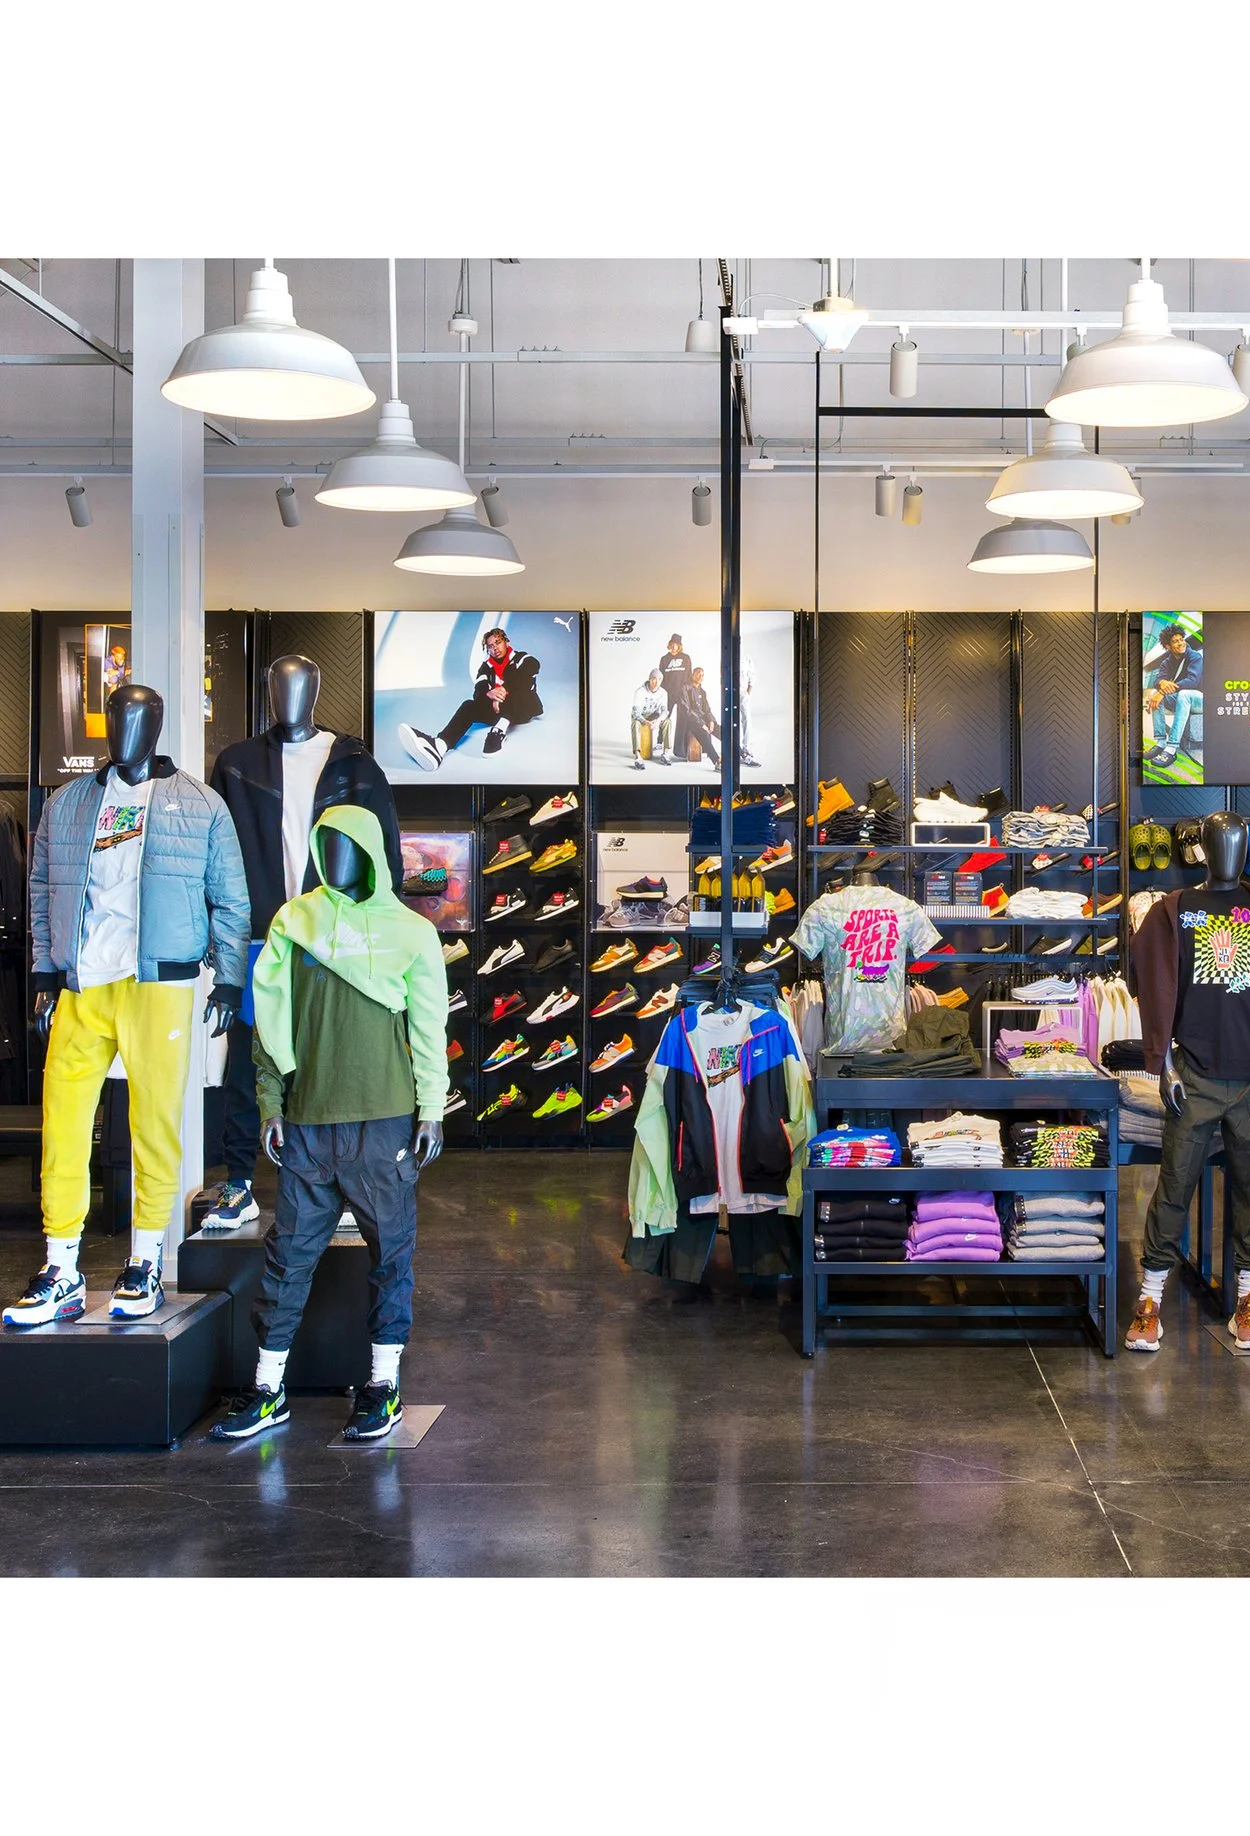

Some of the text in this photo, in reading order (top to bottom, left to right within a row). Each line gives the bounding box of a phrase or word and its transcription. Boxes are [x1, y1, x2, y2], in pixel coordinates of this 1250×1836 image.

[62, 756, 95, 768] VANS
[843, 909, 899, 933] SPORTS
[840, 922, 900, 951] ARE A
